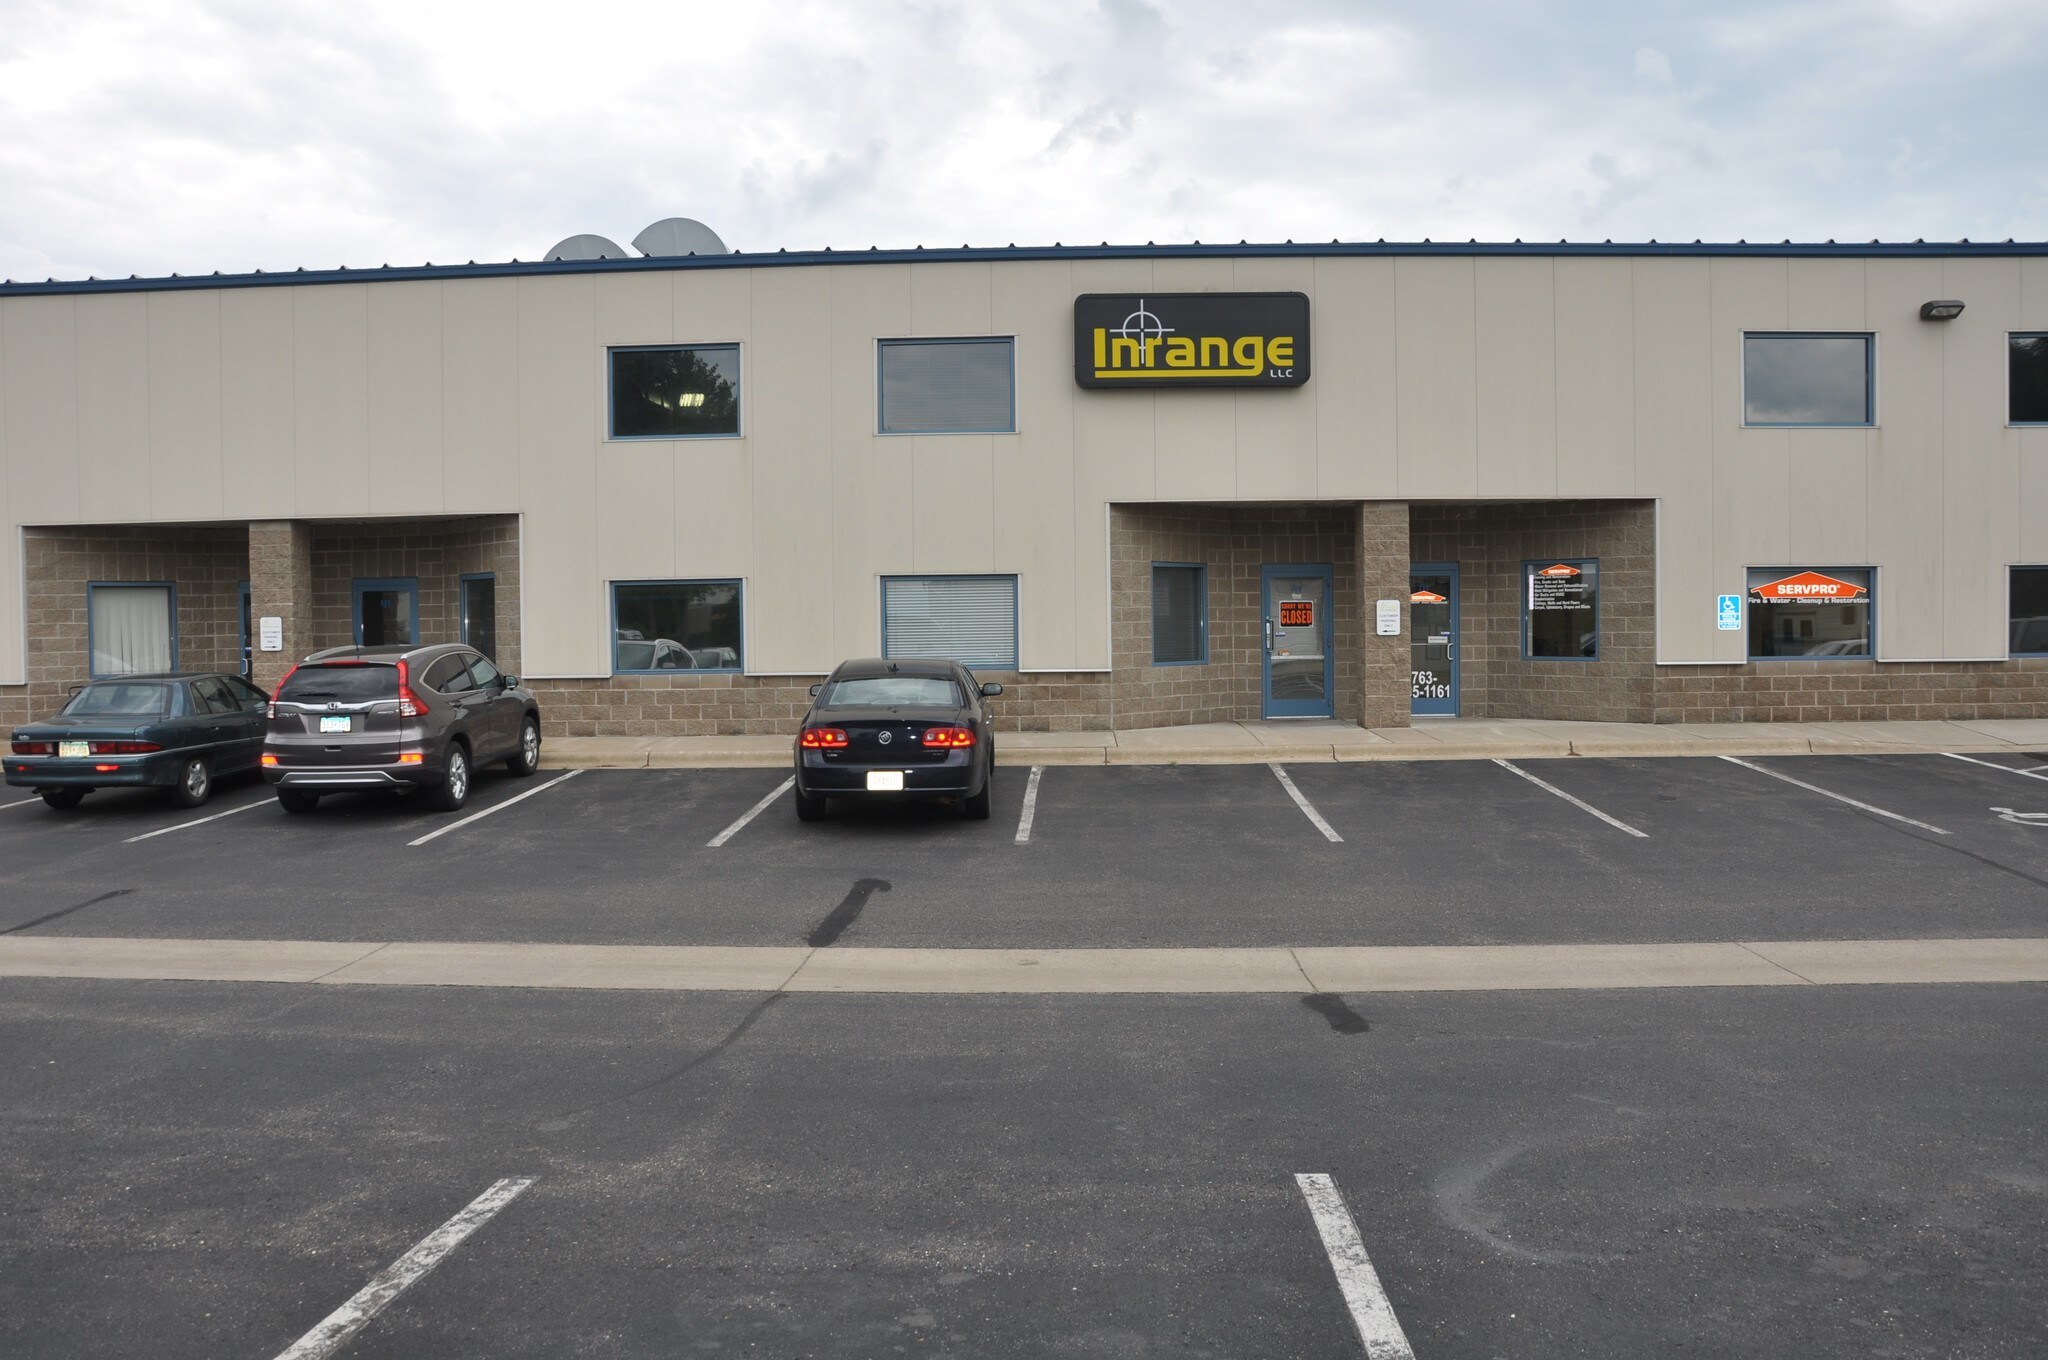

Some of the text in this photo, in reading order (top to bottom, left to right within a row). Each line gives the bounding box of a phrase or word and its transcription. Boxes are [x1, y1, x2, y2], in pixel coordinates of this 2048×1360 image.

[1094, 328, 1294, 378] Inrange
[1270, 369, 1293, 378] LLC
[1777, 584, 1838, 595] SERVPRO
[1797, 597, 1823, 605] Cleanup
[1281, 610, 1312, 624] CLOSED
[1411, 684, 1450, 698] 5-1161
